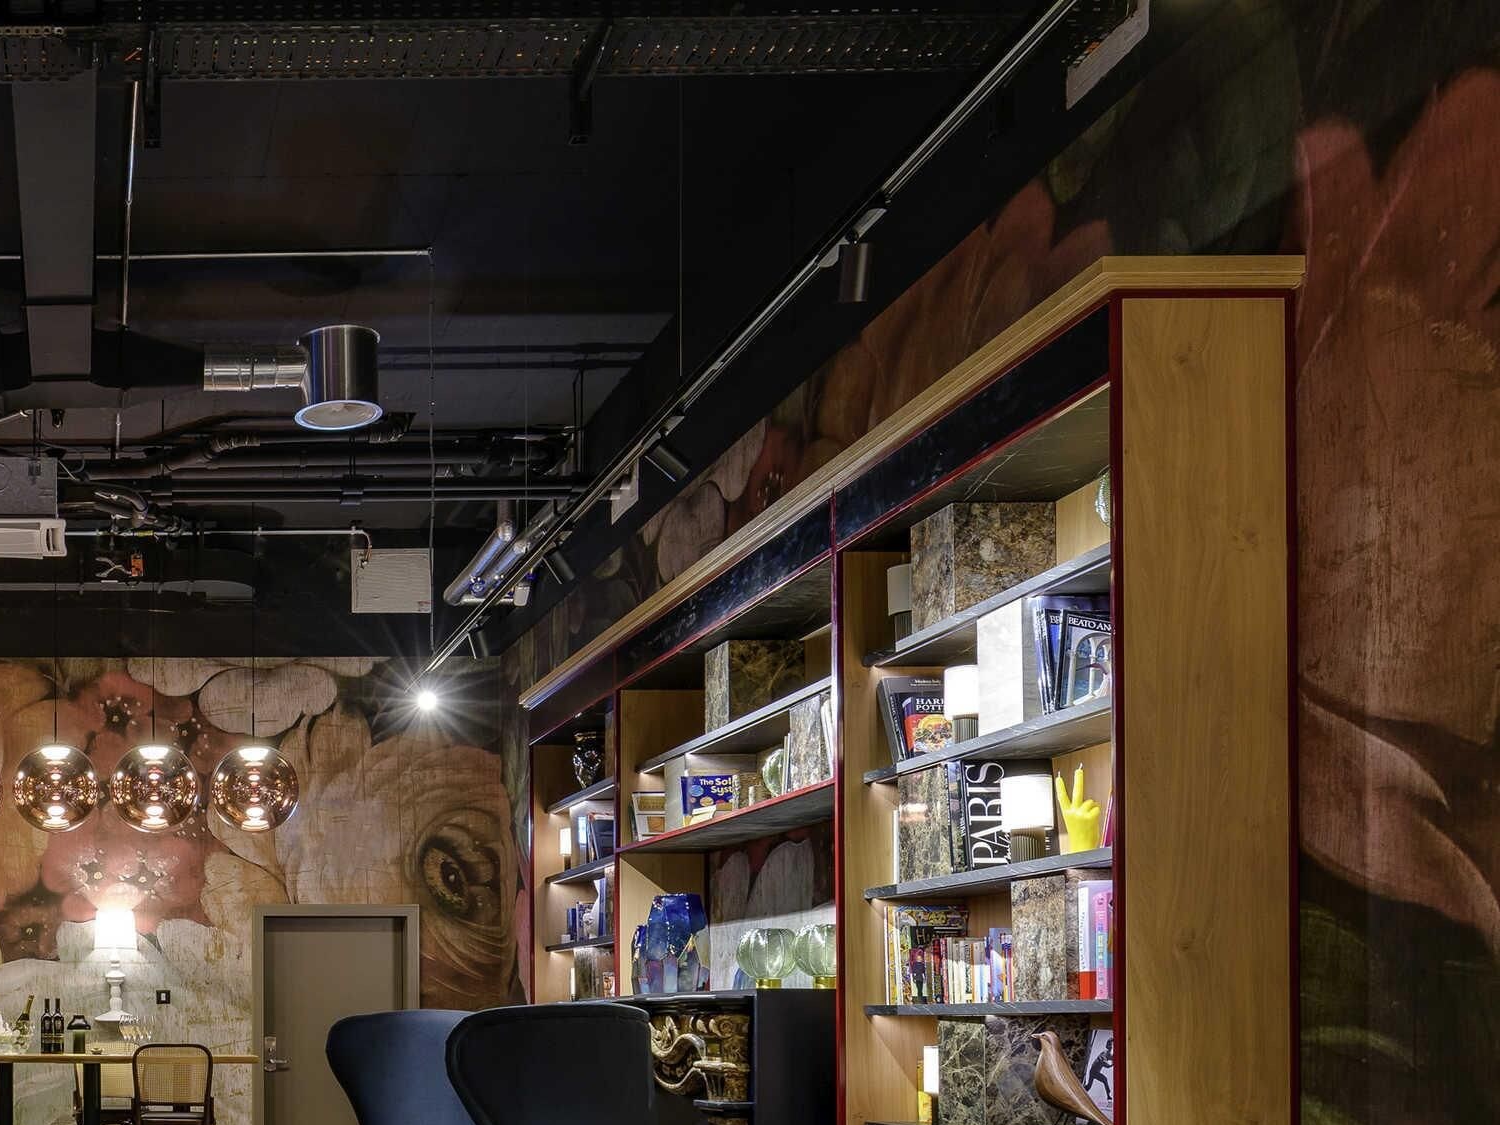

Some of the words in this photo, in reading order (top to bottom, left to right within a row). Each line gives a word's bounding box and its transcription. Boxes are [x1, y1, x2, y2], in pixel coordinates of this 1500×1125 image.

[1068, 616, 1096, 629] BEATO
[700, 778, 714, 786] The
[965, 762, 1009, 868] PARIS
